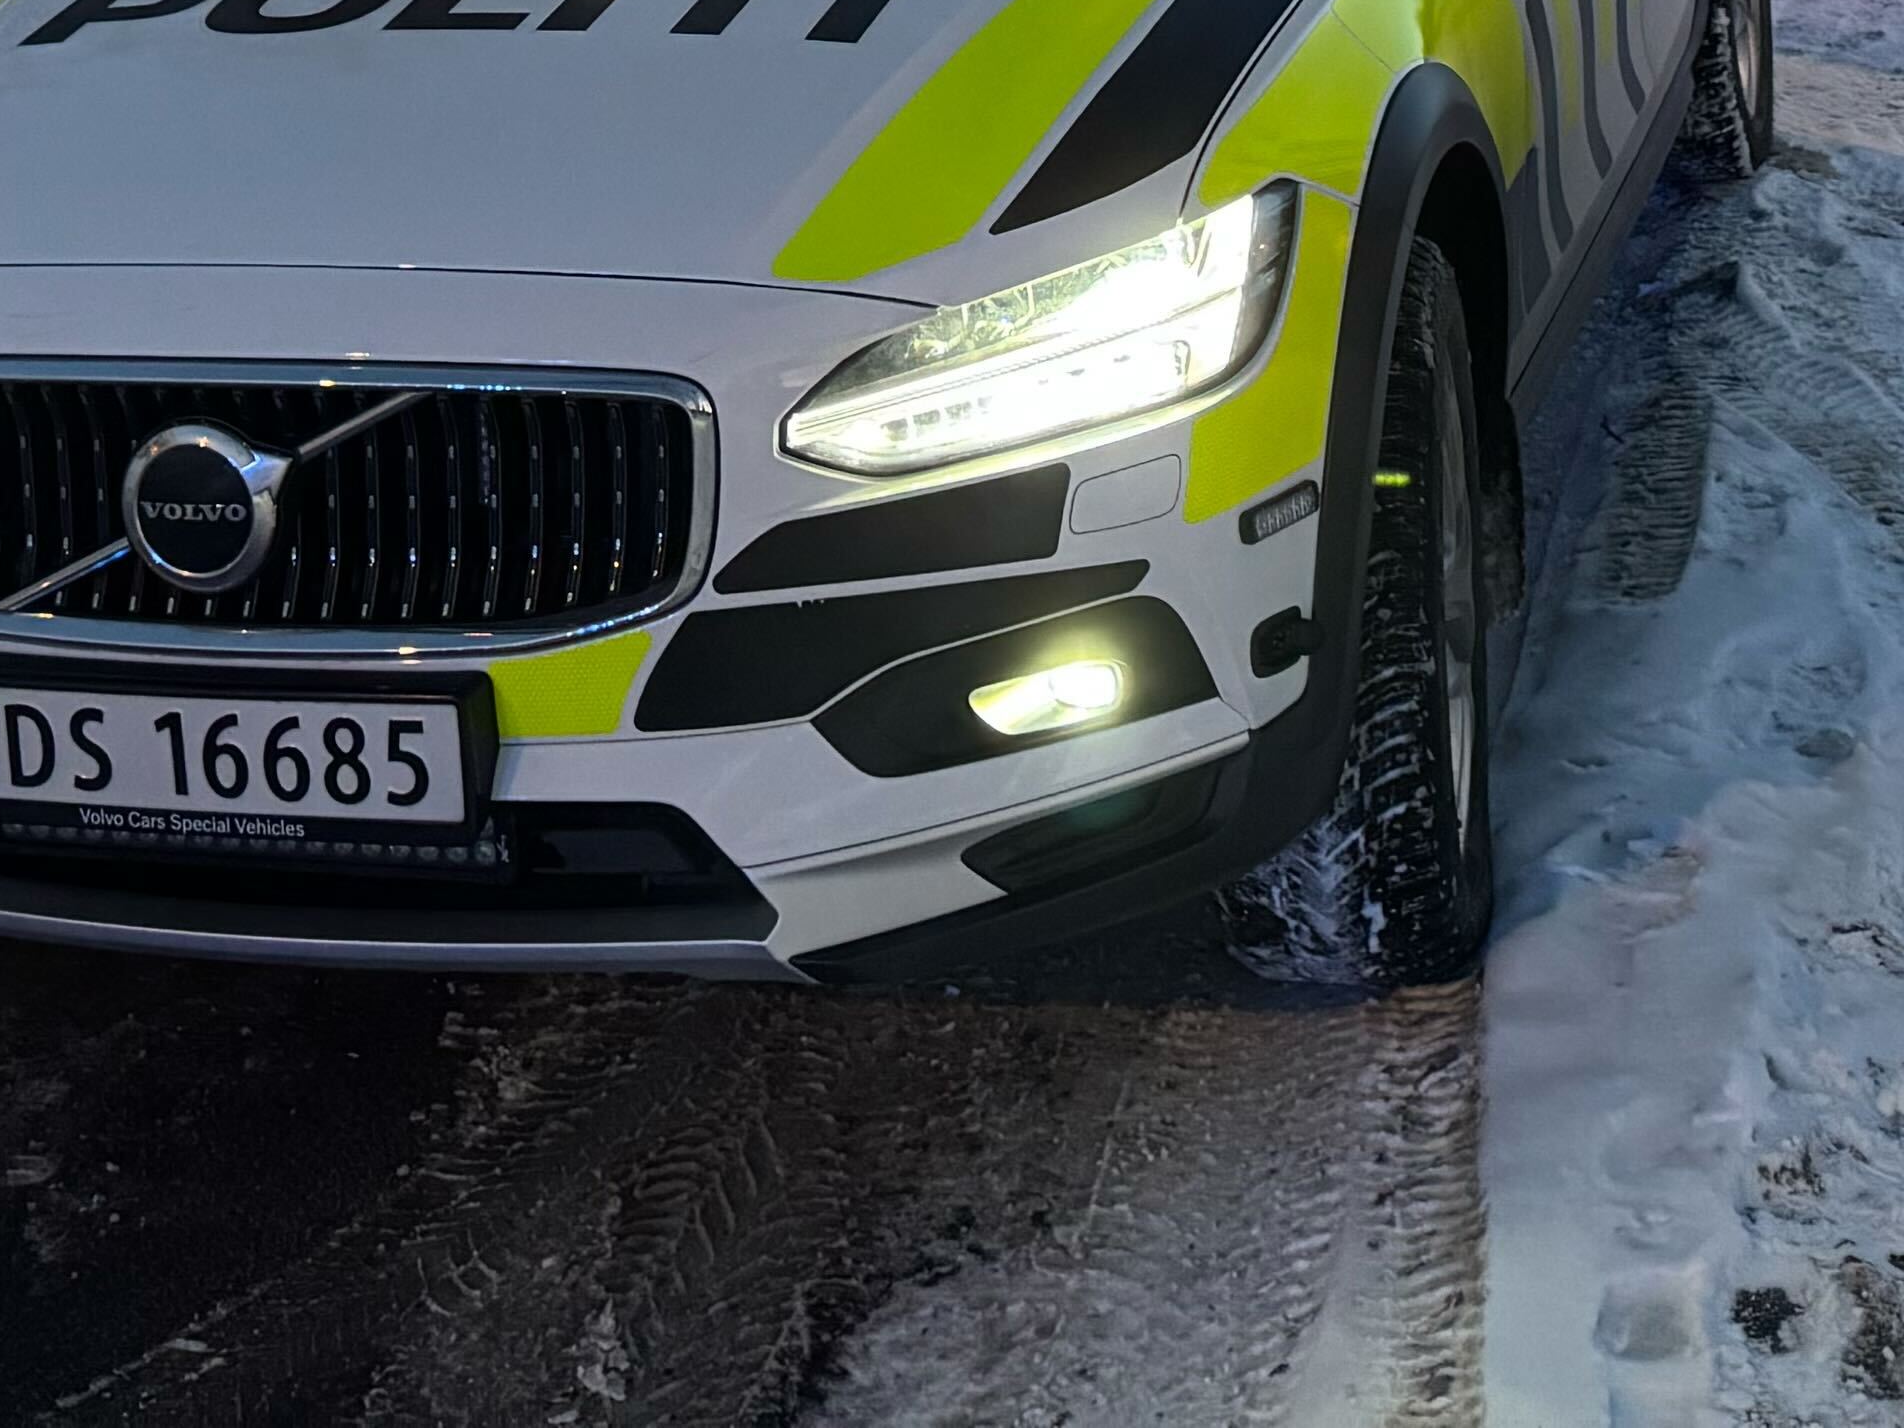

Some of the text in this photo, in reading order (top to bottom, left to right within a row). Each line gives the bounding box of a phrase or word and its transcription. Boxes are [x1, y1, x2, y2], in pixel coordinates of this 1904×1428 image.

[140, 500, 247, 522] VOLVO
[3, 703, 431, 807] DS 16685
[79, 806, 306, 839] Volvo Cars Special Vehicles
